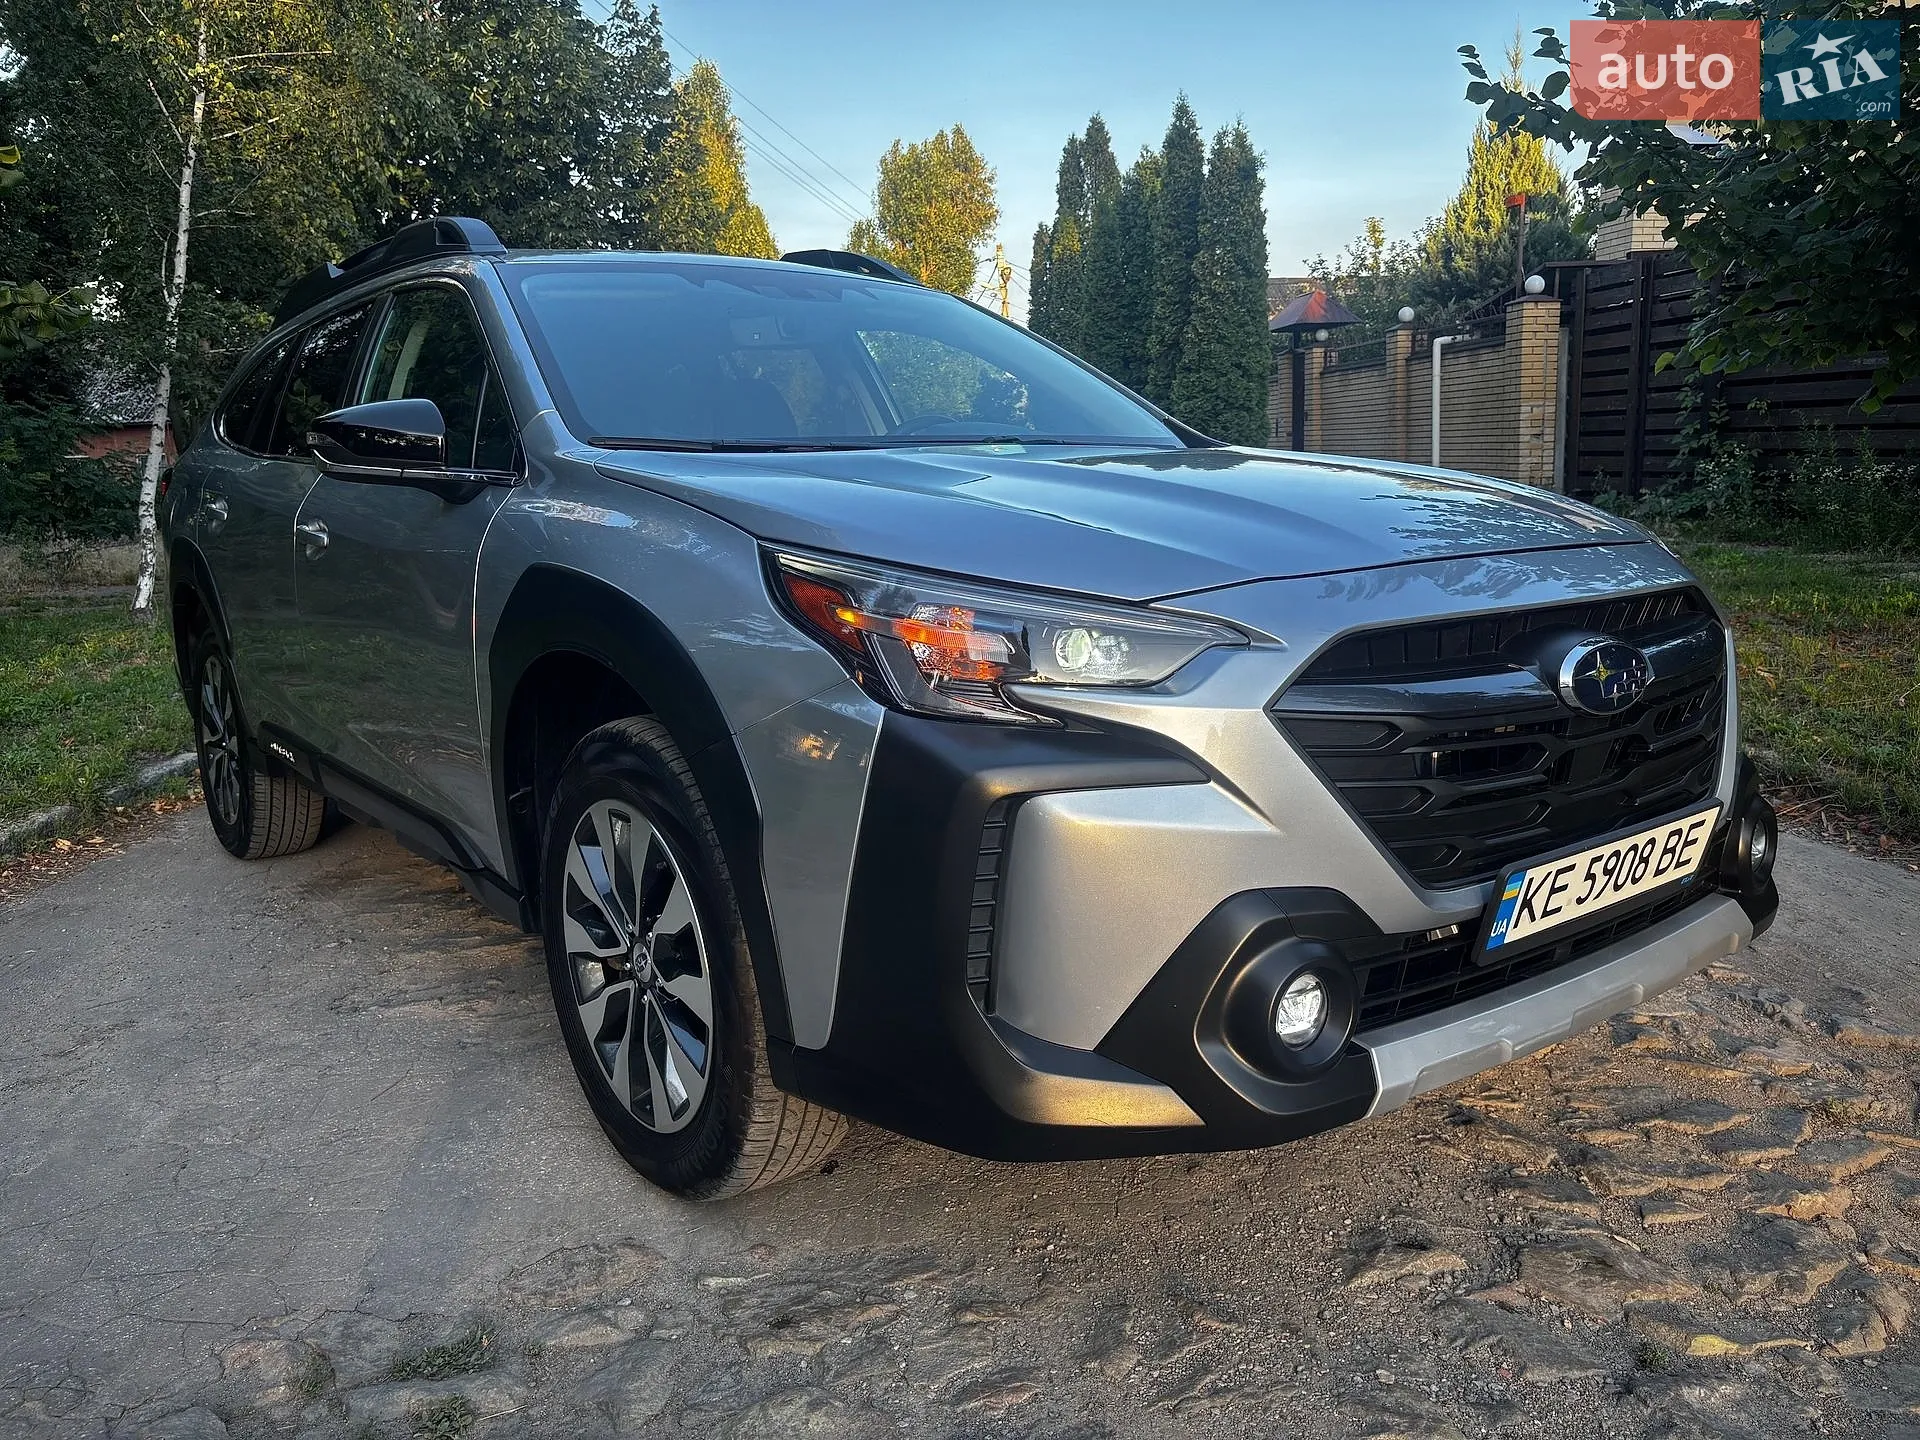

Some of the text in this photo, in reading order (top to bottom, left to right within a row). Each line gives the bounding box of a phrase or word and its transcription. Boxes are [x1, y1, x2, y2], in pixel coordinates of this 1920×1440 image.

[1512, 819, 1706, 930] KE 5908 BE
[1490, 922, 1507, 938] UA
